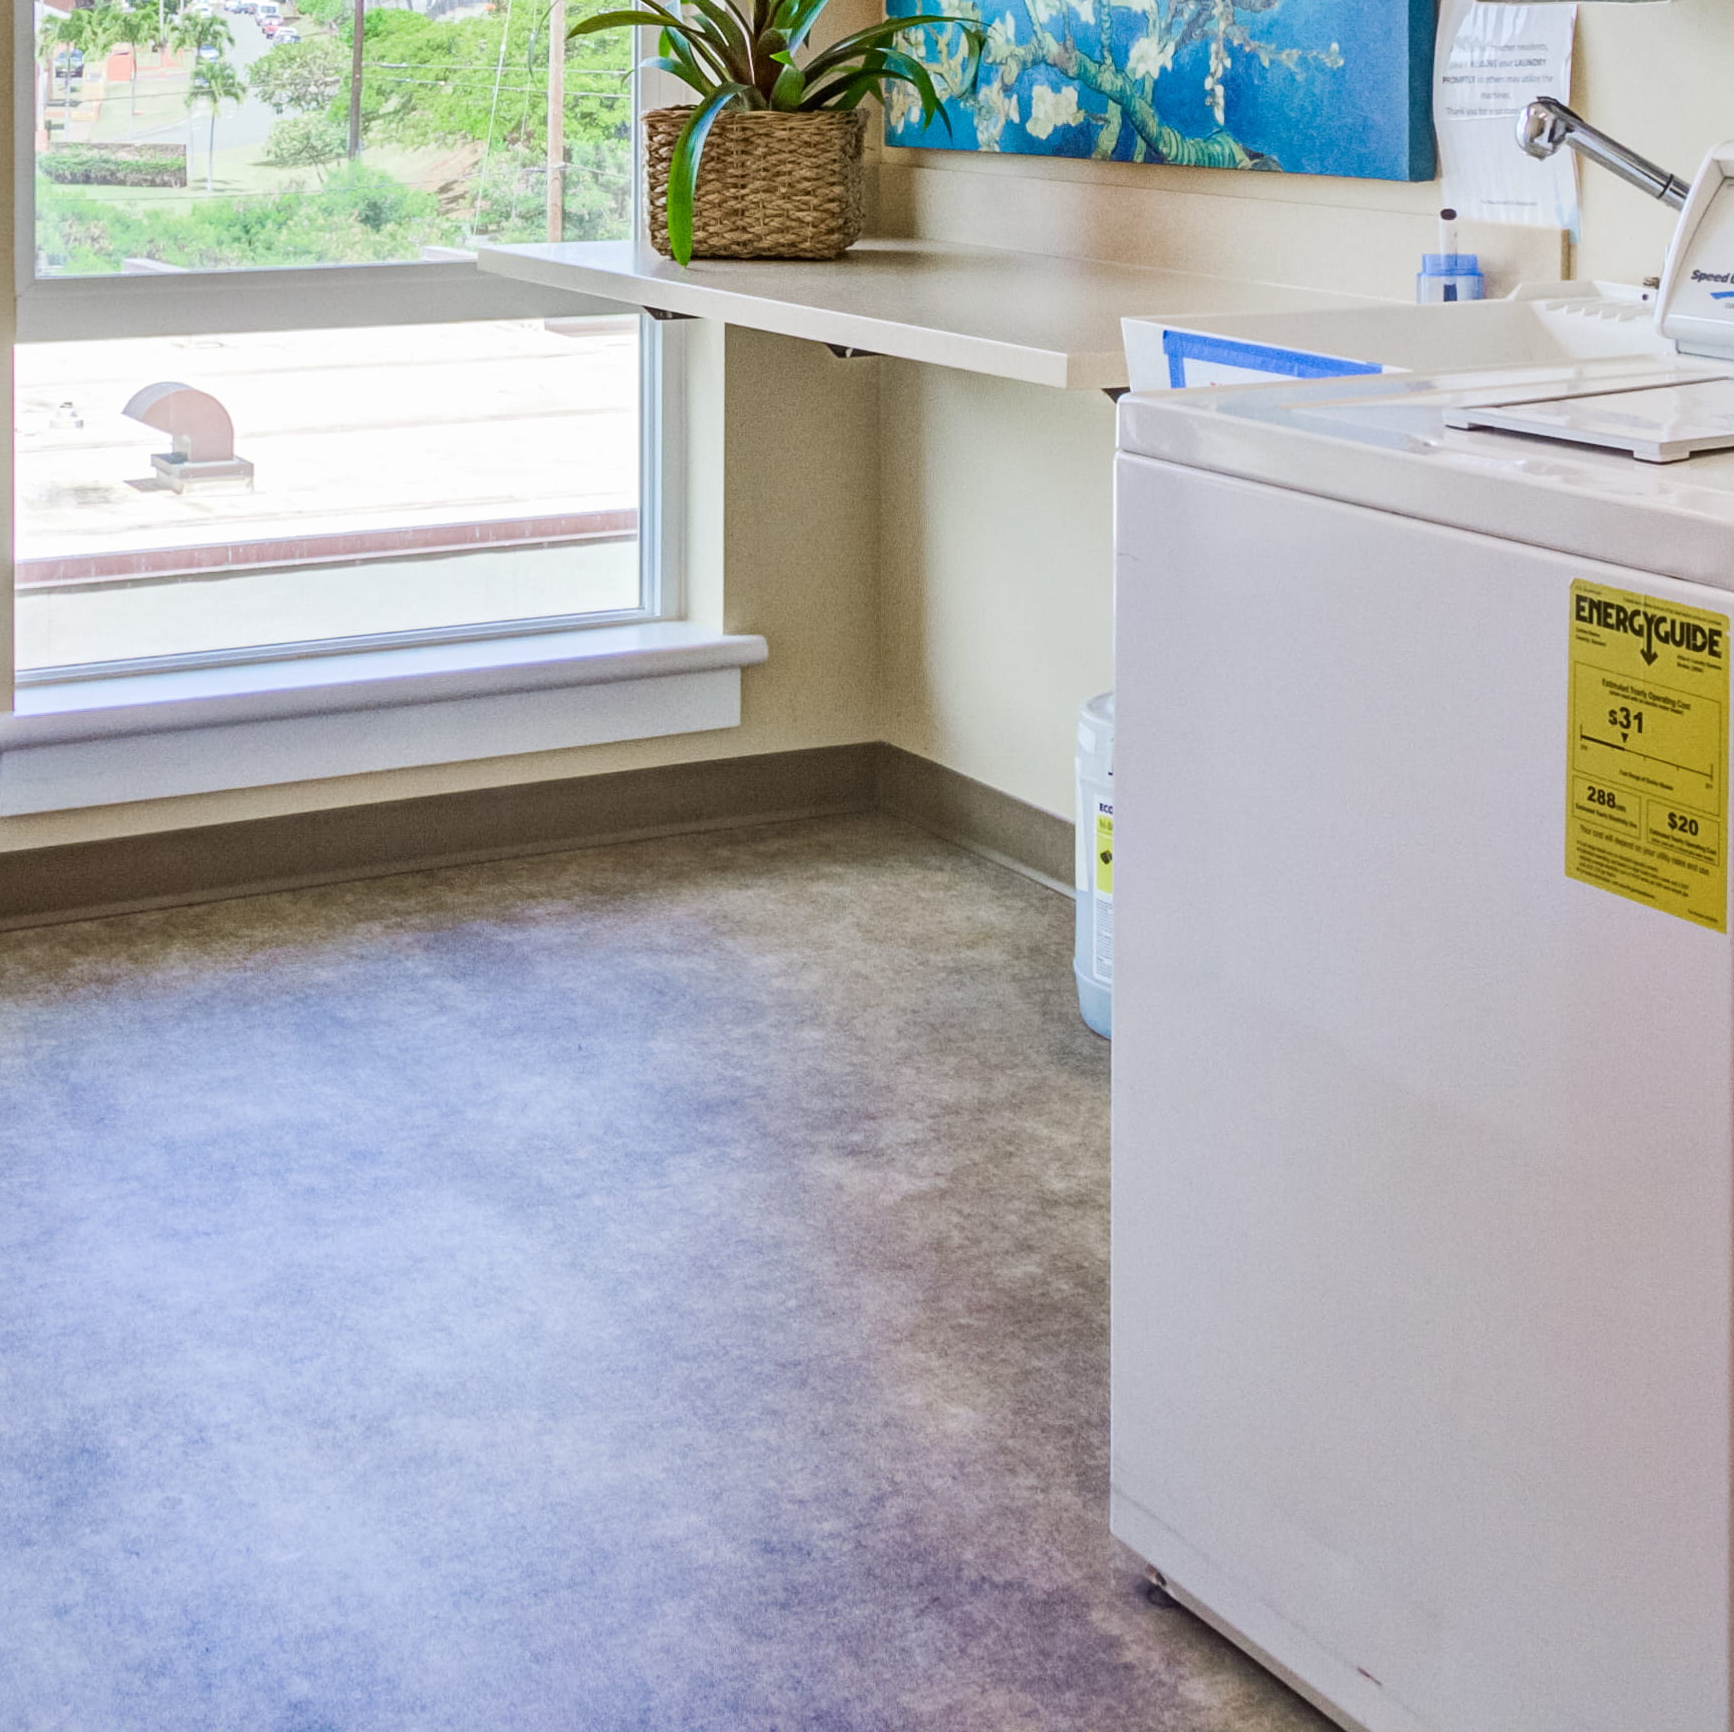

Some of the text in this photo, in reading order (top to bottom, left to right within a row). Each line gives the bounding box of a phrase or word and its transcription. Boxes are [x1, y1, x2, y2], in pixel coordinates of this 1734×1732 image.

[1514, 59, 1546, 67] LAUNDRY
[1442, 76, 1475, 84] PROMPTLY
[1691, 269, 1730, 283] Speed
[1575, 594, 1722, 659] ENERGYGUIDE
[1602, 678, 1629, 693] Estimated
[1630, 686, 1647, 698] Yearly
[1648, 691, 1677, 708] Operating
[1677, 699, 1691, 711] Cost
[1608, 706, 1643, 734] $31
[1667, 811, 1699, 836] $20
[1580, 824, 1591, 835] Your
[1593, 829, 1603, 838] cost
[1605, 833, 1613, 841] will
[1614, 836, 1635, 851] depend
[1643, 847, 1655, 857] your
[1687, 862, 1698, 870] and
